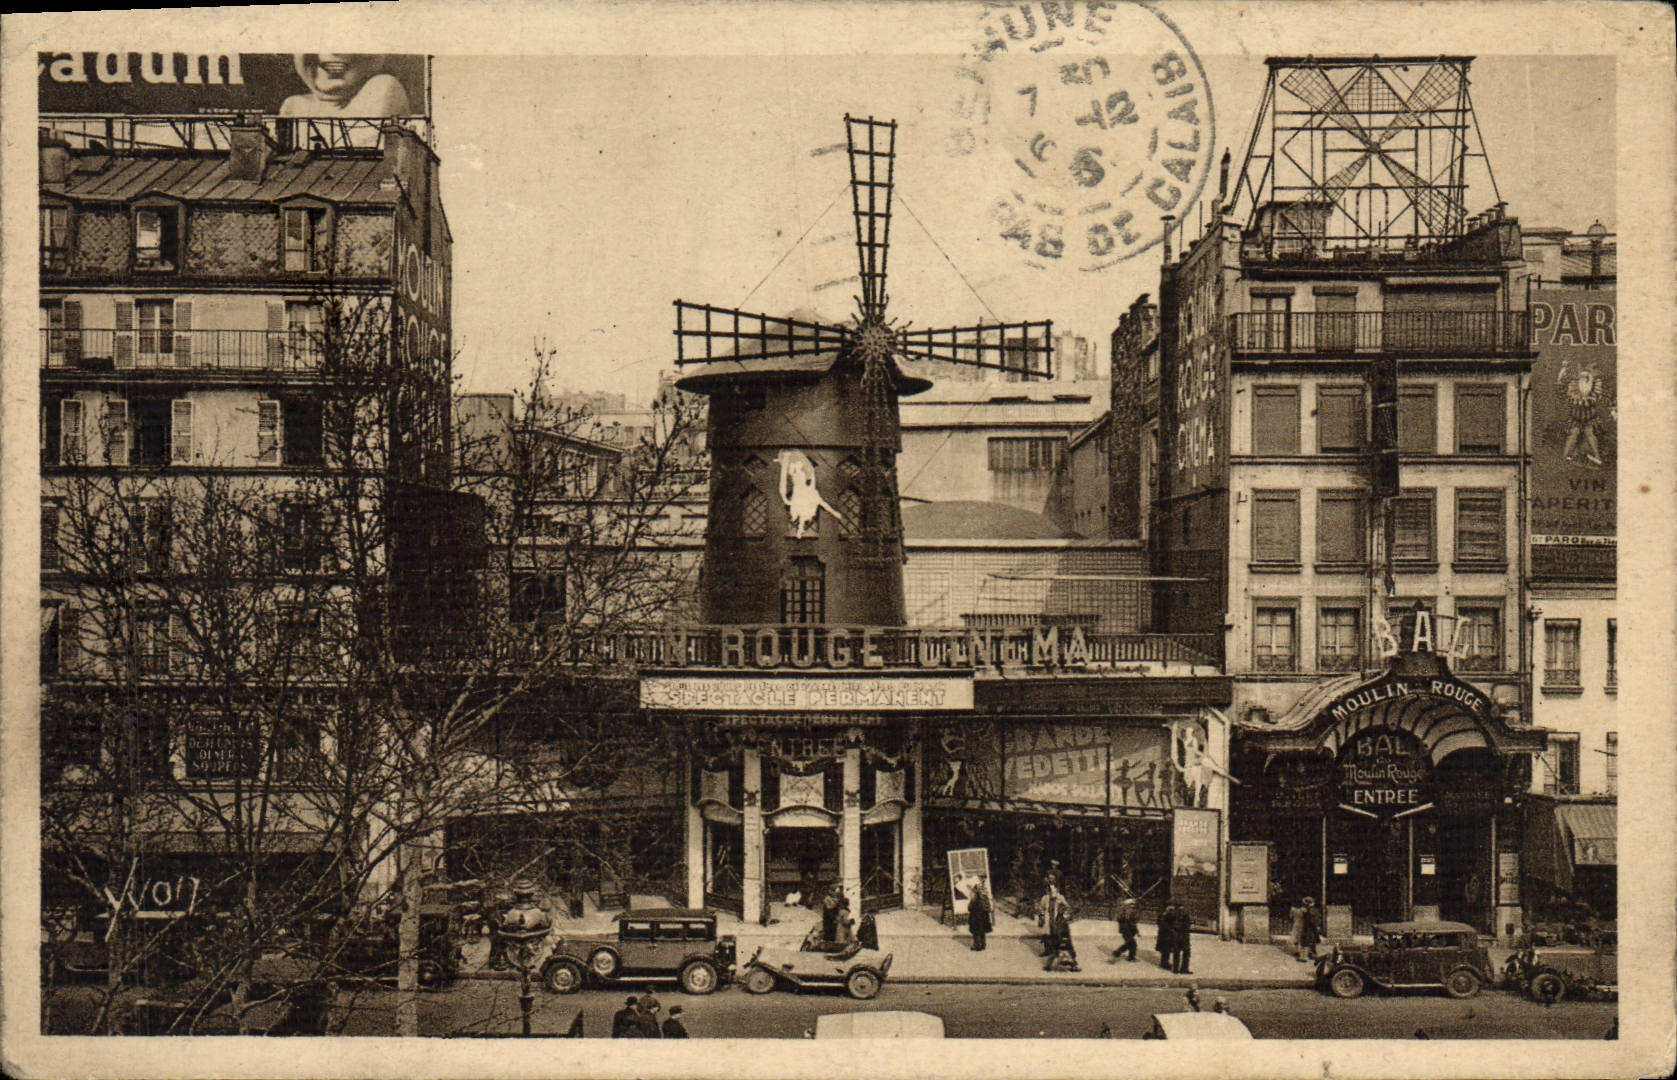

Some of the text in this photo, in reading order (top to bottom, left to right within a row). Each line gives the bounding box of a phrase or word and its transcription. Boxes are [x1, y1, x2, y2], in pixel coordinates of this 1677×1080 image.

[39, 53, 244, 84] adum
[721, 627, 885, 667] ROUGE
[1373, 611, 1471, 659] BAL
[668, 689, 945, 706] SPECTACLE PERMANENT
[1331, 681, 1483, 720] MOULIN ROUGE
[1356, 733, 1411, 757] BAL
